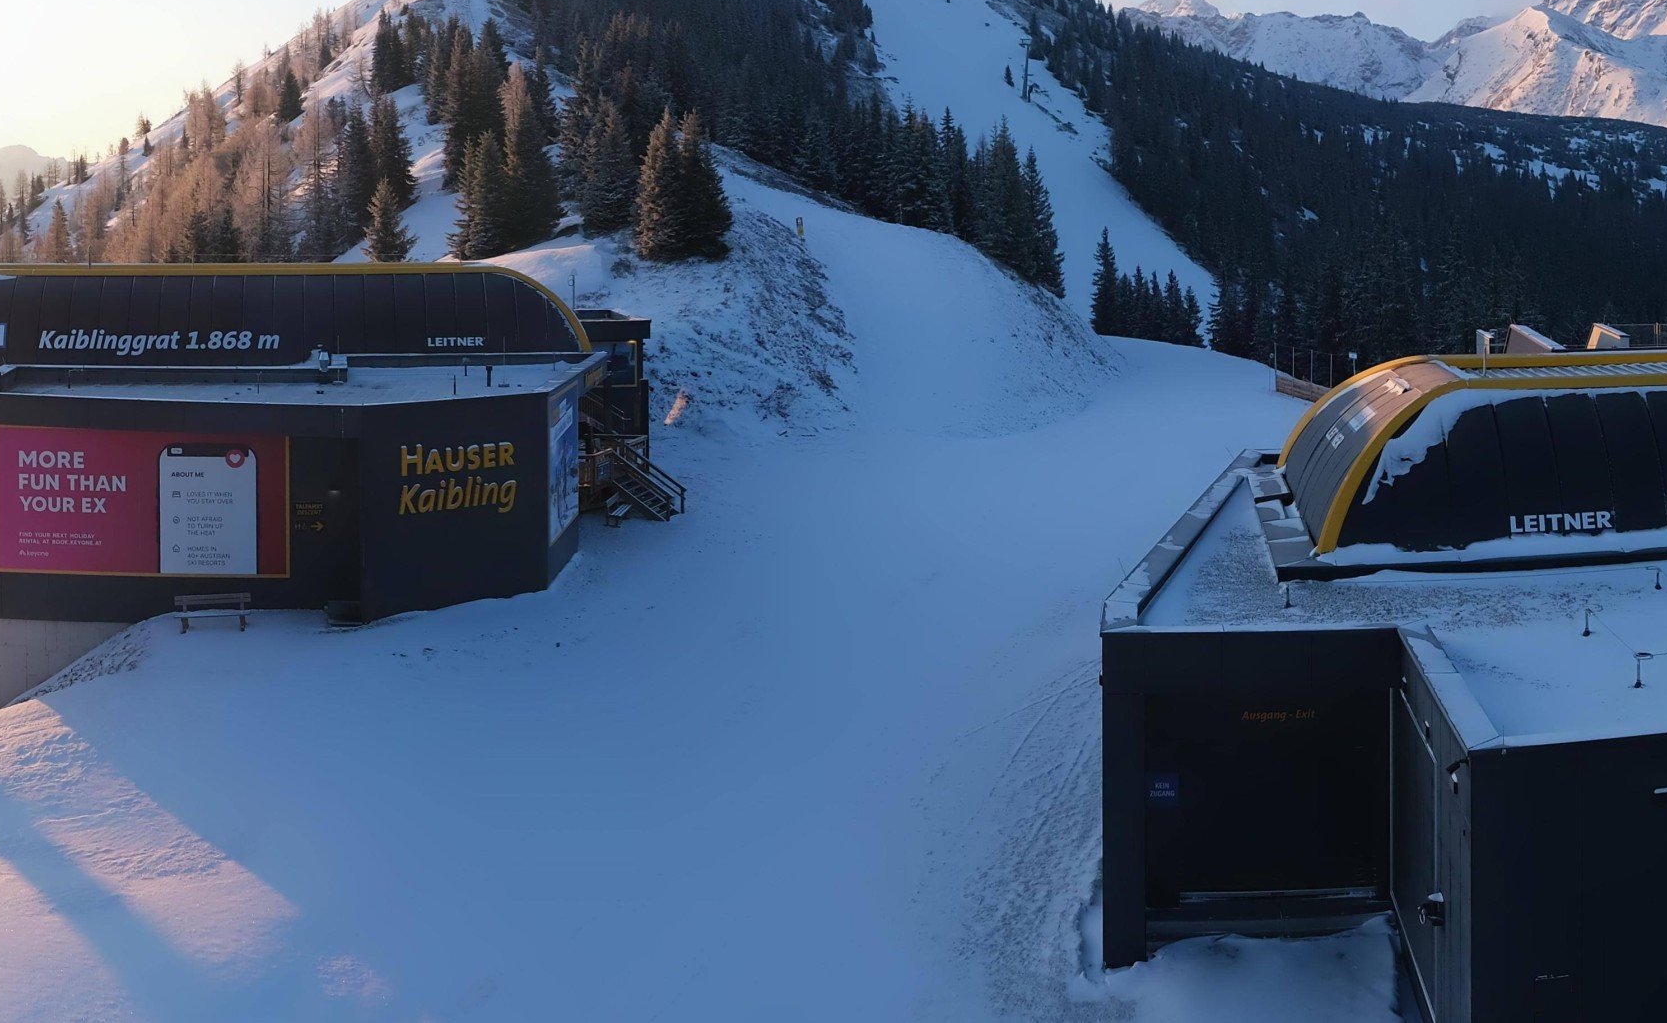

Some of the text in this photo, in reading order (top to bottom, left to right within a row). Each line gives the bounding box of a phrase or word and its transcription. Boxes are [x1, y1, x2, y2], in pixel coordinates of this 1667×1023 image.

[38, 329, 280, 356] Kaiblinggrat 1.868 m
[427, 337, 484, 347] LEITNER
[18, 450, 85, 469] MORE
[401, 442, 515, 476] HAUSER
[18, 473, 126, 492] FUN THAN
[19, 496, 107, 514] YOUR EX
[399, 476, 517, 515] Kaibling
[1509, 511, 1613, 533] LEITNER
[1242, 711, 1287, 723] Ausgang
[1295, 708, 1316, 719] Exit
